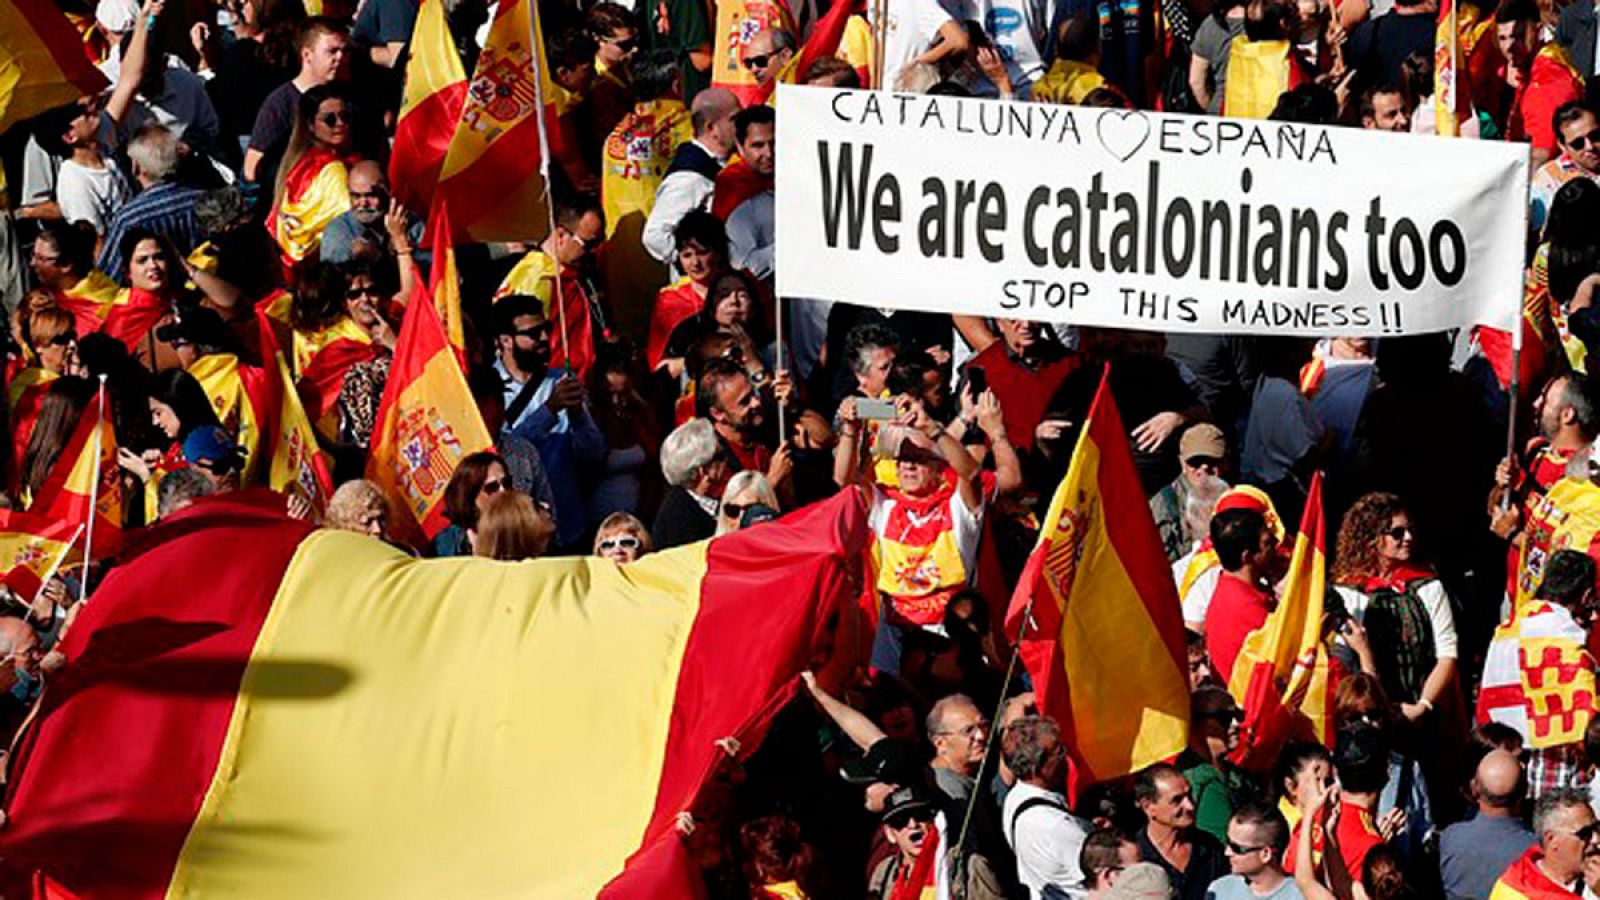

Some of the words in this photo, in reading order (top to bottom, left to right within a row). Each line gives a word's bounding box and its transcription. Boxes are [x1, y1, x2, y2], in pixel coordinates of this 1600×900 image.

[831, 92, 1081, 147] CATALUNYA
[1160, 118, 1337, 164] ESPAÑA
[818, 139, 902, 254] We
[918, 176, 1007, 263] are
[1023, 160, 1349, 293] catalonians
[1364, 195, 1467, 292] too
[1000, 279, 1090, 311] STOP
[1120, 287, 1198, 323] THIS
